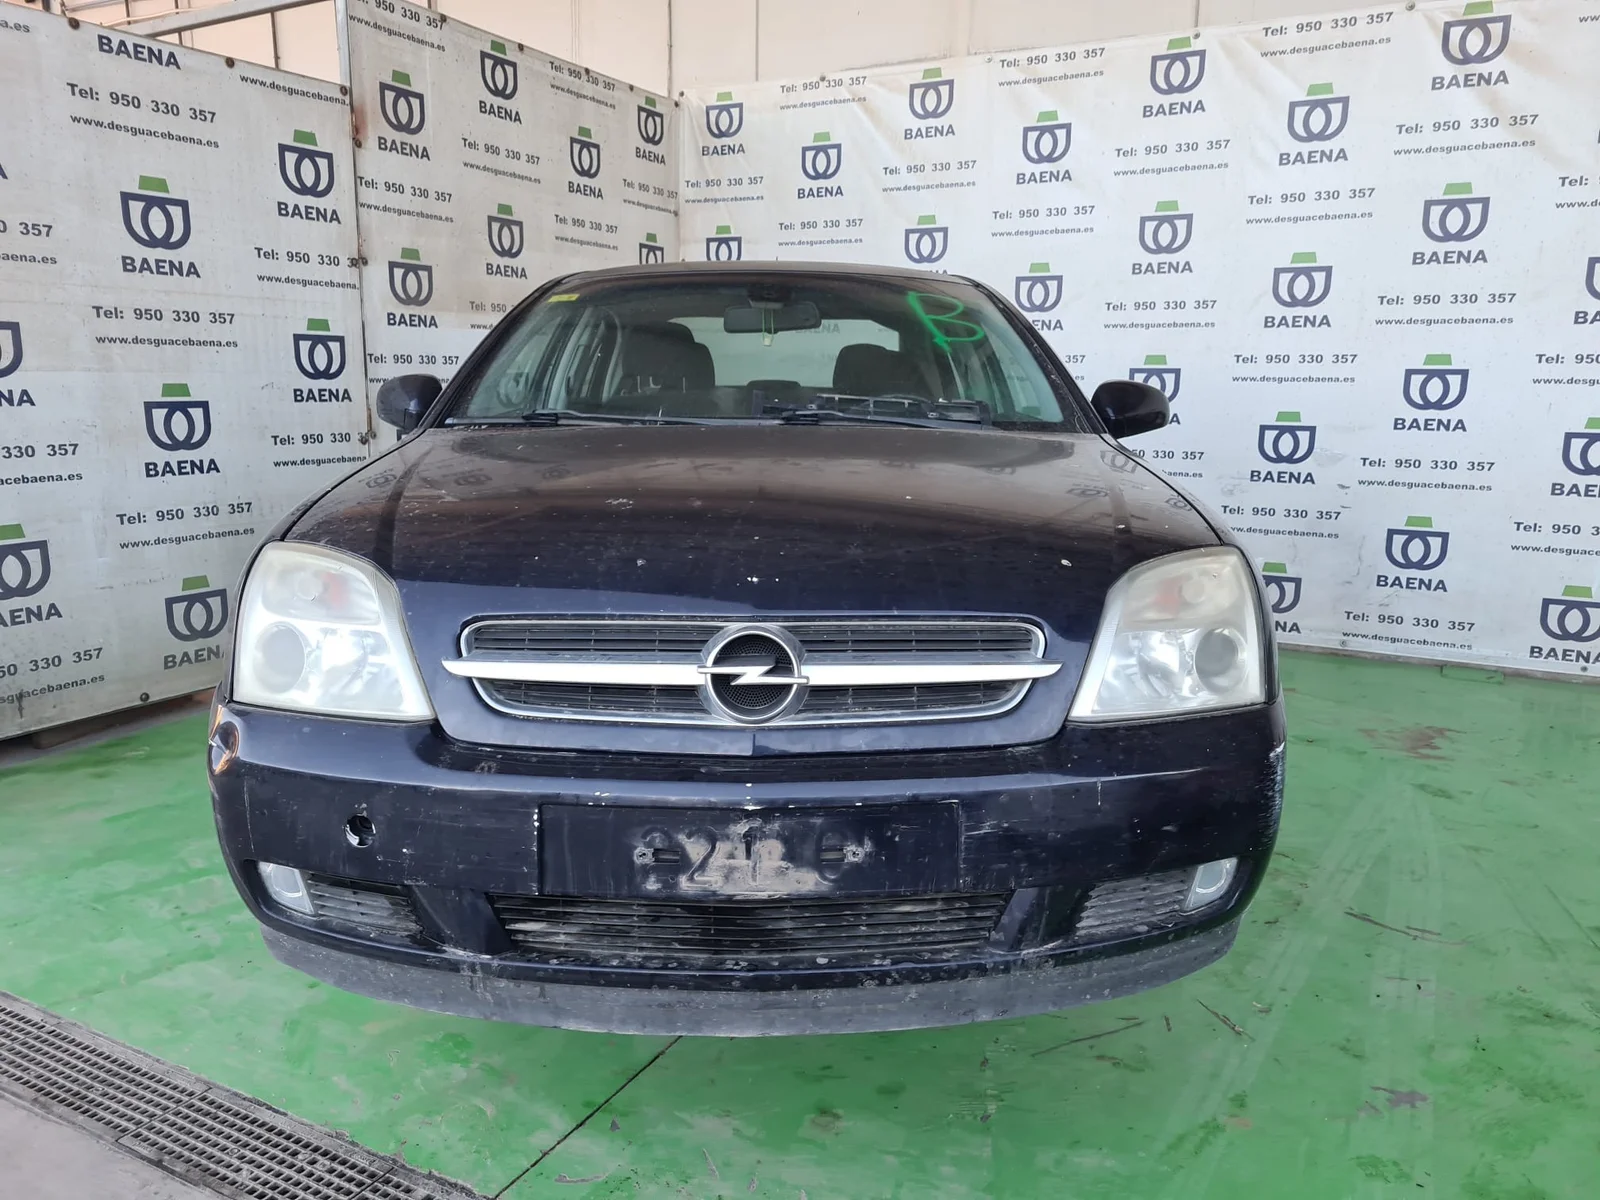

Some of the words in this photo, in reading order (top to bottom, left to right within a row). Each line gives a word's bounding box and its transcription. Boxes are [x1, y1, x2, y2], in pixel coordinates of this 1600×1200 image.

[400, 6, 421, 23] 330
[1262, 25, 1288, 38] Tel:
[1295, 20, 1323, 34] 950
[1330, 16, 1358, 29] 330
[1366, 11, 1394, 25] 357
[97, 34, 181, 70] BAENA
[1260, 36, 1392, 58] www.desguacebaena.es
[999, 57, 1020, 69] Tel:
[1026, 54, 1048, 66] 950
[1054, 50, 1077, 63] 330
[1083, 47, 1106, 60] 357
[779, 83, 798, 94] Tel:
[802, 80, 820, 91] 950
[825, 78, 844, 89] 330
[848, 75, 867, 87] 357
[998, 70, 1105, 87] www.desguacebaena.es
[1430, 69, 1510, 91] BAENA
[239, 73, 349, 107] www.desguacebaena.
[66, 81, 100, 102] Tel:
[109, 91, 142, 110] 950
[150, 99, 180, 117] 330
[188, 107, 217, 124] 357
[1142, 99, 1206, 119] BAENA
[478, 99, 523, 125] BAENA
[70, 113, 220, 149] www.desguacebaena.es
[903, 123, 956, 141] BAENA
[1395, 123, 1424, 135] Tel:
[1432, 119, 1461, 133] 950
[1470, 116, 1500, 130] 330
[1508, 113, 1539, 127] 357
[377, 135, 431, 162] BAENA
[461, 137, 480, 151] Tel:
[483, 143, 501, 157] 950
[504, 148, 521, 161] 330
[525, 153, 541, 166] 357
[635, 146, 666, 166] BAENA
[701, 143, 746, 157] BAENA
[1114, 147, 1138, 158] Tel:
[1144, 144, 1168, 156] 950
[1175, 141, 1199, 153] 330
[1206, 139, 1231, 151] 357
[1393, 139, 1536, 156] www.desguacebaena.es
[1278, 147, 1349, 167] BAENA
[882, 165, 901, 176] Tel:
[906, 163, 926, 174] 950
[931, 161, 951, 172] 330
[956, 159, 977, 170] 357
[1113, 162, 1229, 177] www.desguacebaena.es
[684, 179, 702, 189] Tel:
[705, 178, 722, 188] 950
[726, 177, 743, 187] 330
[747, 175, 764, 186] 357
[1015, 169, 1073, 185] BAENA
[1558, 175, 1589, 188] Tel:
[358, 176, 378, 190] Tel:
[383, 181, 405, 195] 950
[410, 185, 429, 200] 330
[434, 190, 453, 203] 357
[567, 180, 604, 200] BAENA
[797, 185, 844, 200] BAENA
[1247, 194, 1273, 205] Tel:
[1280, 192, 1306, 204] 950
[1314, 189, 1341, 202] 330
[1348, 187, 1376, 200] 357
[276, 200, 342, 225] BAENA
[359, 201, 454, 223] www.desguacebaena.es
[992, 210, 1013, 220] Tel:
[1018, 208, 1040, 219] 950
[1045, 206, 1067, 218] 330
[1073, 204, 1096, 216] 357
[1245, 211, 1374, 225] www.desguacebaena.es
[18, 221, 53, 238] 357
[778, 222, 796, 231] Tel:
[800, 220, 818, 230] 950
[822, 219, 841, 229] 330
[845, 218, 864, 228] 357
[990, 227, 1094, 238] www.desguacebaena.es
[253, 246, 279, 261] Tel:
[286, 250, 311, 264] 950
[317, 253, 340, 267] 330
[1411, 249, 1488, 266] BAENA
[121, 255, 202, 279] BAENA
[485, 262, 528, 280] BAENA
[1131, 260, 1193, 276] BAENA
[256, 274, 360, 291] www.desguacebaena.
[1104, 301, 1127, 312] Tel:
[1133, 301, 1157, 311] 950
[1163, 300, 1187, 311] 330
[1193, 299, 1218, 310] 357
[1377, 295, 1405, 306] Tel:
[1413, 294, 1441, 305] 950
[1449, 293, 1479, 305] 330
[1487, 292, 1517, 304] 357
[91, 305, 125, 320] Tel:
[133, 307, 164, 322] 950
[172, 309, 201, 324] 330
[208, 311, 235, 325] 357
[386, 312, 439, 329] BAENA
[1263, 314, 1332, 329] BAENA
[1374, 316, 1514, 327] www.desguacebaena.es
[1103, 320, 1216, 330] www.desguacebaena.es
[95, 335, 238, 348] www.desguacebaena.es
[366, 352, 387, 364] Tel:
[392, 353, 413, 365] 950
[418, 354, 437, 365] 330
[441, 355, 460, 366] 357
[1064, 354, 1086, 364] 357
[1233, 354, 1258, 364] Tel:
[1265, 354, 1291, 364] 950
[1298, 354, 1324, 364] 330
[1331, 353, 1358, 364] 357
[1535, 353, 1565, 364] Tel:
[1231, 375, 1356, 385] www.desguacebaena.es
[293, 388, 353, 403] BAENA
[1393, 417, 1467, 433] BAENA
[270, 434, 295, 446] Tel:
[301, 433, 324, 445] 950
[330, 432, 351, 444] 330
[1, 444, 36, 460] 330
[46, 443, 79, 457] 357
[1152, 449, 1175, 460] 330
[1181, 450, 1205, 461] 357
[144, 458, 221, 478] BAENA
[273, 455, 367, 467] www.desguacebaena
[1360, 457, 1386, 468] Tel:
[1394, 458, 1422, 469] 950
[1430, 459, 1458, 471] 330
[1466, 461, 1496, 472] 357
[1249, 469, 1316, 485] BAENA
[1357, 479, 1493, 492] www.desguacebaena.es
[115, 511, 147, 526] Tel:
[155, 508, 185, 522] 950
[193, 504, 220, 518] 330
[227, 501, 253, 515] 357
[1220, 504, 1245, 515] Tel:
[1251, 506, 1276, 517] 950
[1283, 508, 1308, 519] 330
[1315, 510, 1342, 521] 357
[1513, 521, 1542, 533] Tel:
[1551, 523, 1582, 535] 950
[119, 527, 255, 550] www.desguacebaena.es
[1375, 574, 1448, 593] BAENA
[1344, 610, 1370, 622] Tel:
[1377, 613, 1404, 626] 950
[1412, 617, 1439, 629] 330
[1447, 620, 1476, 632] 357
[1339, 631, 1472, 650] www.desguacebaena.es
[28, 654, 62, 672] 330
[72, 647, 103, 664] 357
